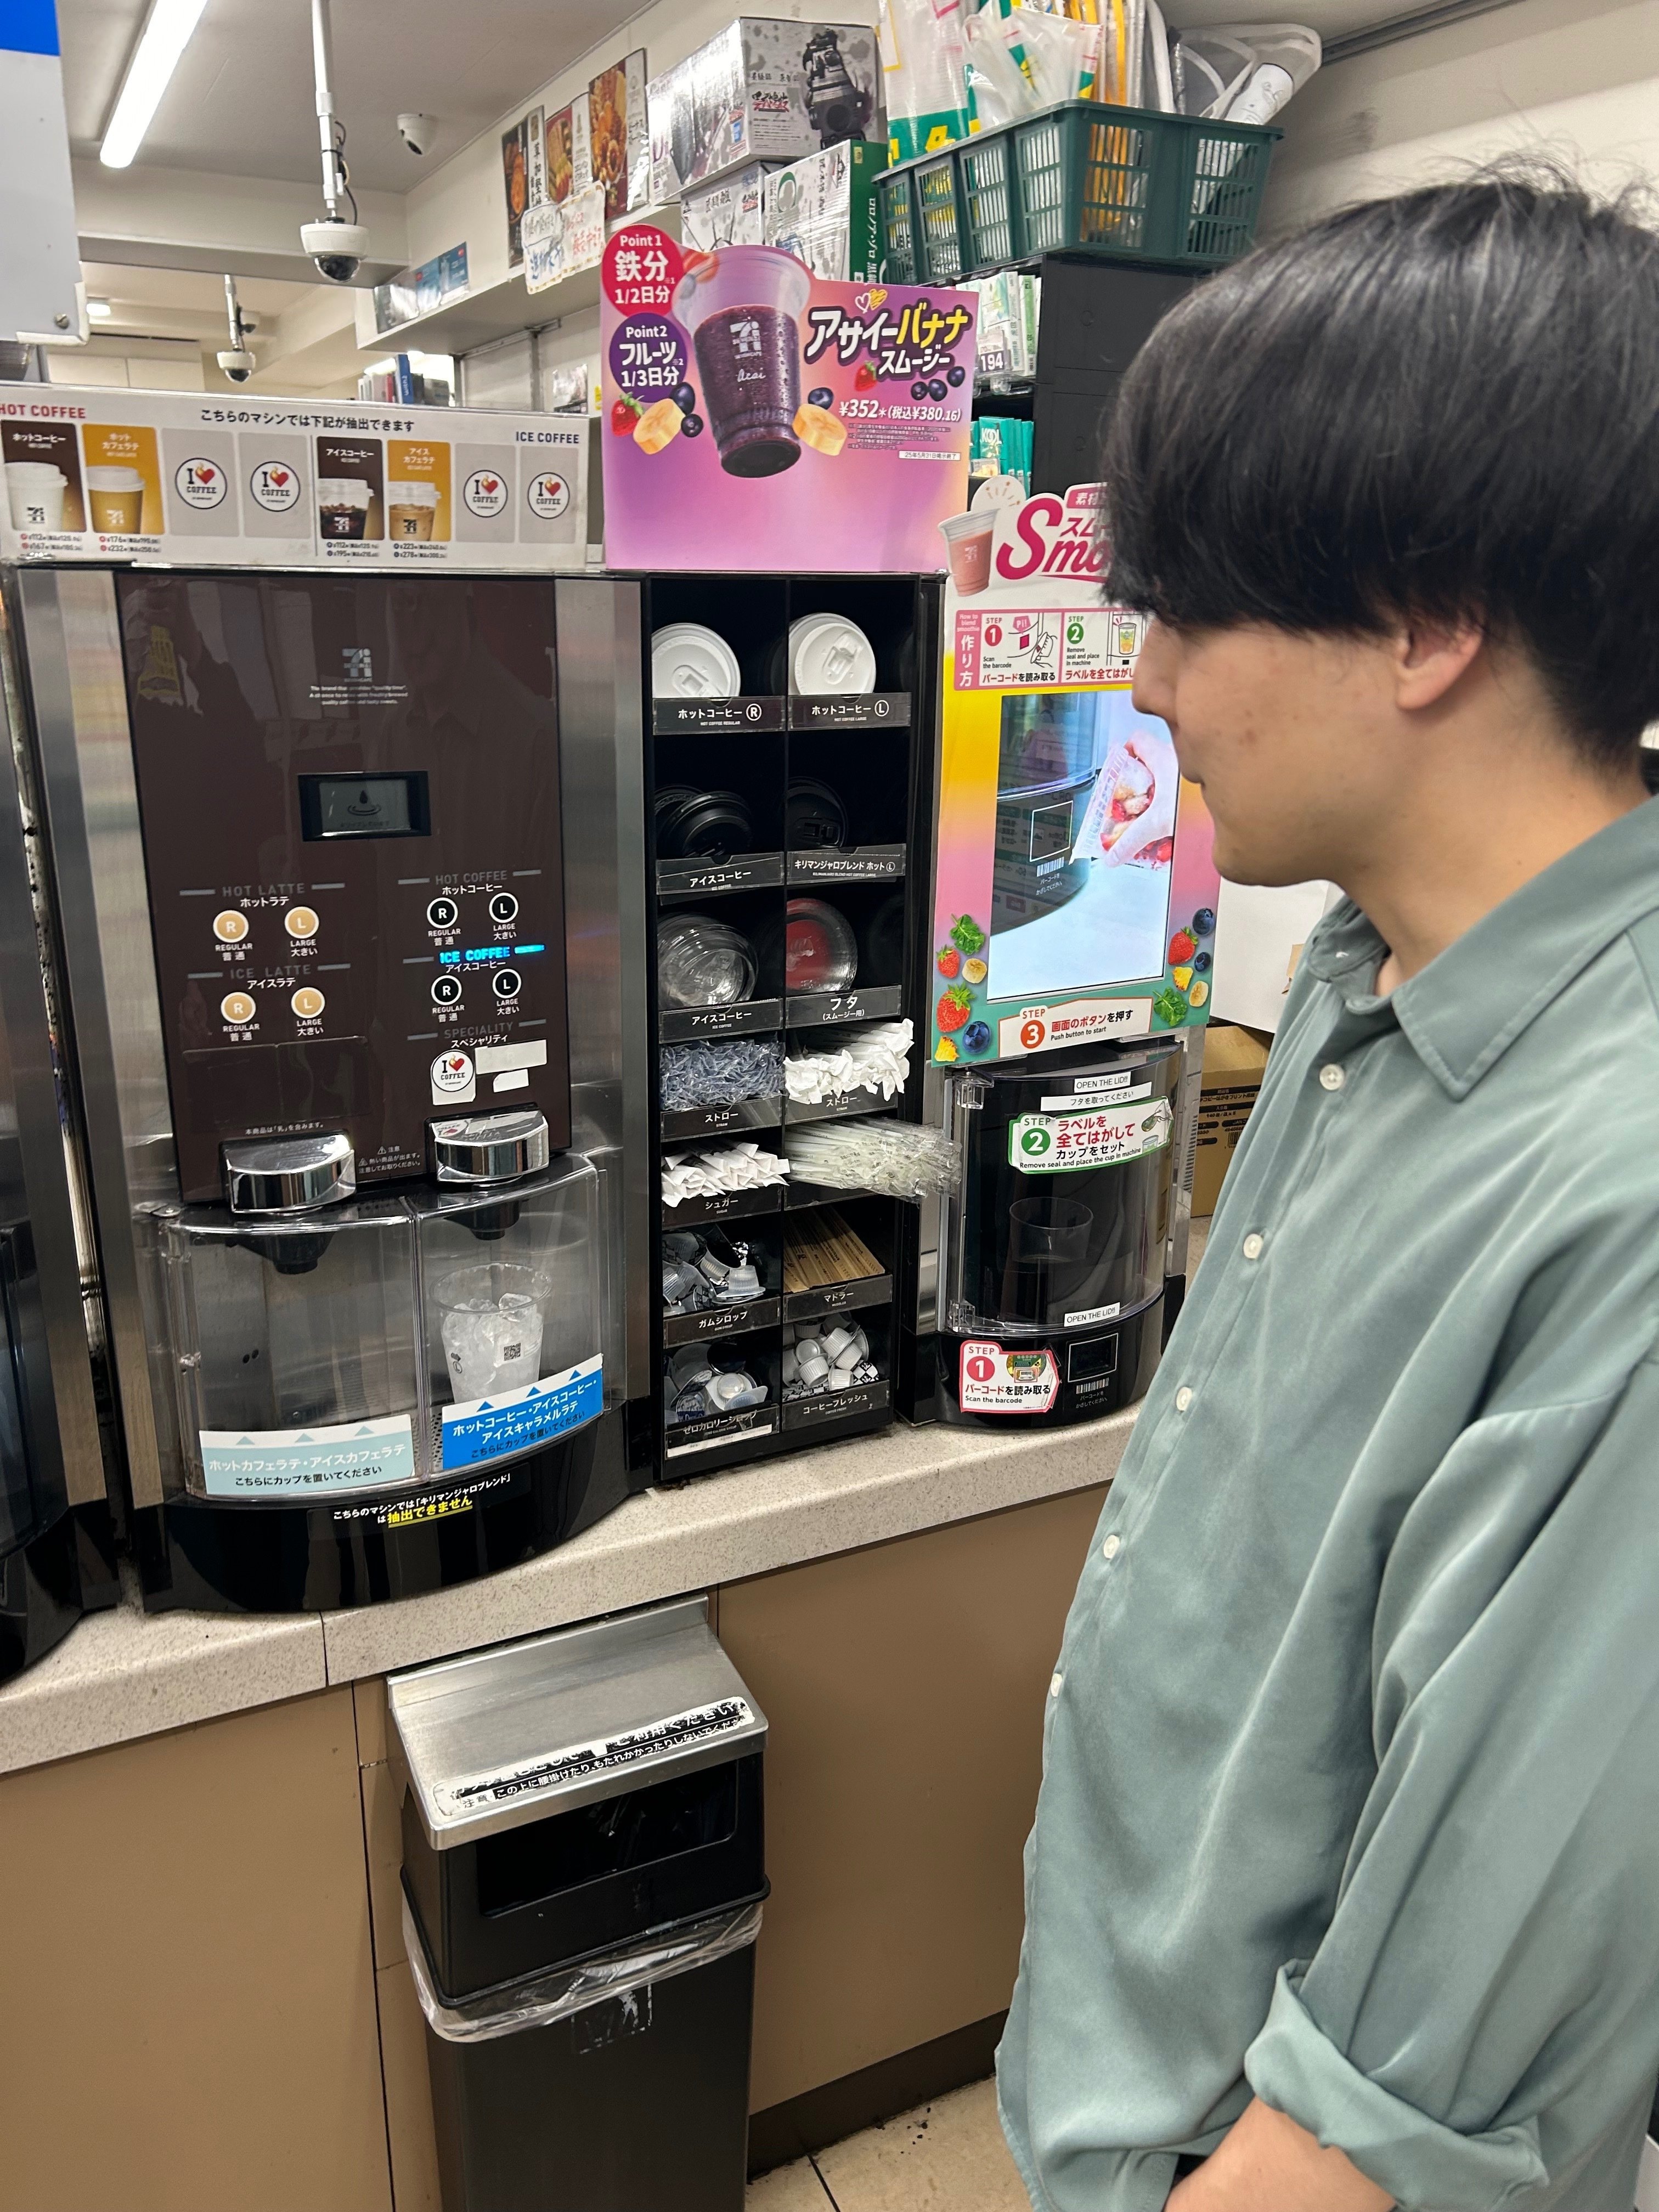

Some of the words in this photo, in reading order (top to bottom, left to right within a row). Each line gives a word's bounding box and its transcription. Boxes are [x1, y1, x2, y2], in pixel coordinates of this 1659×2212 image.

[620, 235, 652, 247] Point
[656, 235, 662, 246] 1
[614, 252, 669, 283] 鉄分
[614, 286, 670, 304] 1/2日分
[807, 301, 969, 358] アサイーバナナ
[619, 343, 676, 366] フルーツ
[879, 345, 951, 375] スムージー
[981, 353, 1003, 371] 194
[620, 367, 679, 387] 1/3日分
[0, 404, 26, 415] HOT
[31, 405, 86, 419] COFFEE
[201, 409, 415, 432] こちらのマシンでは下記が抽出できます
[13, 433, 66, 443] ホットコーヒー
[516, 431, 534, 442] ICE
[538, 432, 580, 444] COFFEE
[326, 448, 375, 458] アイスコーヒー
[409, 448, 430, 456] アイス
[186, 486, 217, 494] COFFEE
[261, 489, 291, 497] COFFEE
[989, 628, 997, 644] 1
[1071, 626, 1080, 641] 2
[960, 635, 975, 687] 作り方
[983, 672, 1056, 684] バーコードを読み取る
[1065, 668, 1133, 680] ラベルを全てはがし
[678, 708, 743, 720] ホットコーヒー
[812, 705, 871, 715] ホットコーヒー
[794, 860, 865, 871] キリマンジャロブレンド
[866, 862, 885, 871] ホット
[436, 873, 459, 885] HOT
[463, 870, 508, 883] COFFEE
[690, 871, 752, 888] アイスコーヒー
[222, 885, 252, 897] HOT
[258, 883, 305, 895] LATTE
[442, 883, 503, 895] ホットコーヒー
[240, 896, 289, 908] ホットラテ
[499, 902, 508, 914] L
[438, 907, 447, 919] R
[225, 921, 236, 933] R
[297, 917, 307, 929] L
[493, 923, 516, 932] LARGE
[428, 928, 461, 937] REGULAR
[494, 931, 517, 941] 大きい
[215, 943, 253, 952] REGULAR
[290, 939, 317, 947] LARGE
[291, 947, 318, 957] 大きい
[439, 951, 461, 964] ICE
[465, 946, 510, 962] COFFEE
[230, 968, 254, 979] ICE
[264, 964, 312, 977] LATTE
[445, 961, 506, 973] アイスコーヒー
[247, 977, 296, 989] アイスラテ
[503, 978, 511, 990] L
[442, 985, 452, 996] R
[233, 1002, 244, 1014] R
[303, 997, 313, 1009] L
[496, 998, 519, 1007] LARGE
[831, 996, 858, 1009] フタ
[432, 1005, 465, 1014] REGULAR
[497, 1006, 520, 1016] 大きい
[822, 1008, 865, 1021] (スムージー用)
[1022, 1008, 1046, 1019] STEP
[296, 1018, 322, 1027] LARGE
[692, 1011, 752, 1025] アイスコーヒー
[1051, 1009, 1134, 1032] 画面のボタンを押す
[222, 1023, 260, 1032] REGULAR
[297, 1027, 324, 1036] 大きい
[444, 1021, 514, 1039] SPECIALITY
[1051, 1031, 1064, 1041] Push
[1065, 1030, 1085, 1040] button
[1093, 1026, 1107, 1035] start
[1026, 1023, 1040, 1045] 3
[451, 1034, 509, 1048] スペシャリティ
[441, 1072, 465, 1081] COFFEE
[1076, 1079, 1097, 1090] OPEN
[1099, 1078, 1113, 1087] THE
[826, 1096, 857, 1107] ストロー
[1070, 1091, 1133, 1107] フタを取ってください
[704, 1111, 739, 1123] ストロー
[1024, 1117, 1052, 1126] STEP
[1057, 1116, 1107, 1131] ラベルを
[1028, 1131, 1043, 1151] 2
[1057, 1122, 1136, 1148] 全てはがして
[1056, 1142, 1125, 1160] カップをセット
[1076, 1158, 1093, 1167] place
[1105, 1155, 1115, 1163] cup
[1122, 1147, 1142, 1158] machine
[704, 1199, 739, 1210] シュガー
[823, 1291, 855, 1302] マドラー
[698, 1310, 748, 1329] ガムシロップ
[1067, 1314, 1087, 1323] OPEN
[1088, 1311, 1101, 1320] THE
[969, 1346, 996, 1355] STEP
[974, 1359, 984, 1378] 1
[965, 1384, 1051, 1396] バーコードを読み取る
[803, 1394, 868, 1414] コーヒーフレッシュ
[482, 1401, 578, 1444] アイスキャラメルラテ
[471, 1411, 585, 1458] こちらにカップを置いてください
[209, 1443, 406, 1472] ホットカフェラテ・アイスカフェラテ
[235, 1466, 382, 1486] こちらにカップを置いてください
[334, 1473, 511, 1520] こちらのマシンでは「キリマンジャロブレンド」
[377, 1496, 473, 1524] は抽出できません
